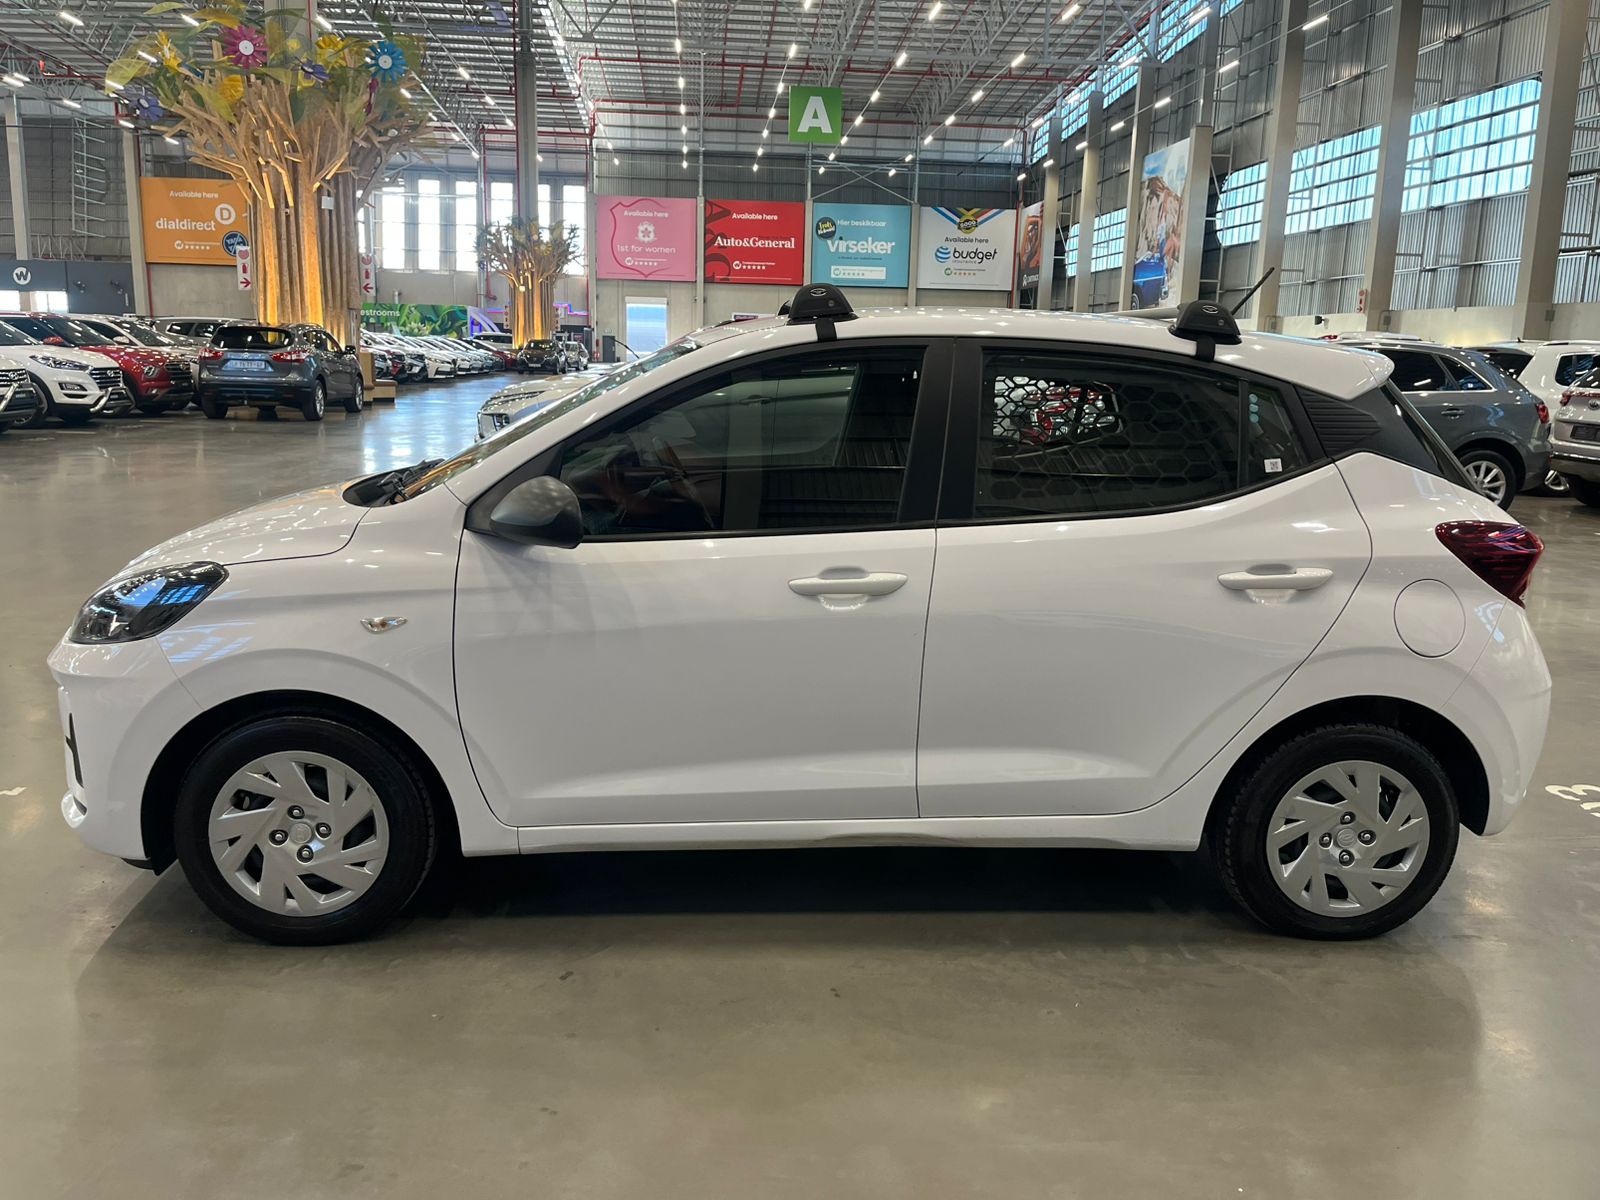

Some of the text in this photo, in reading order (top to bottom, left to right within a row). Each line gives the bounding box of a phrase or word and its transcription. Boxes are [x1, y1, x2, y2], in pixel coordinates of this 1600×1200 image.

[797, 95, 833, 134] A
[169, 190, 202, 199] Available
[155, 218, 216, 231] dialdirect
[850, 219, 887, 227] beskikbaar
[617, 244, 629, 252] 1st
[645, 246, 676, 254] women
[714, 236, 795, 249] Auto&General
[827, 236, 896, 254] virseker
[952, 247, 998, 264] budget
[360, 309, 401, 317] estrooms
